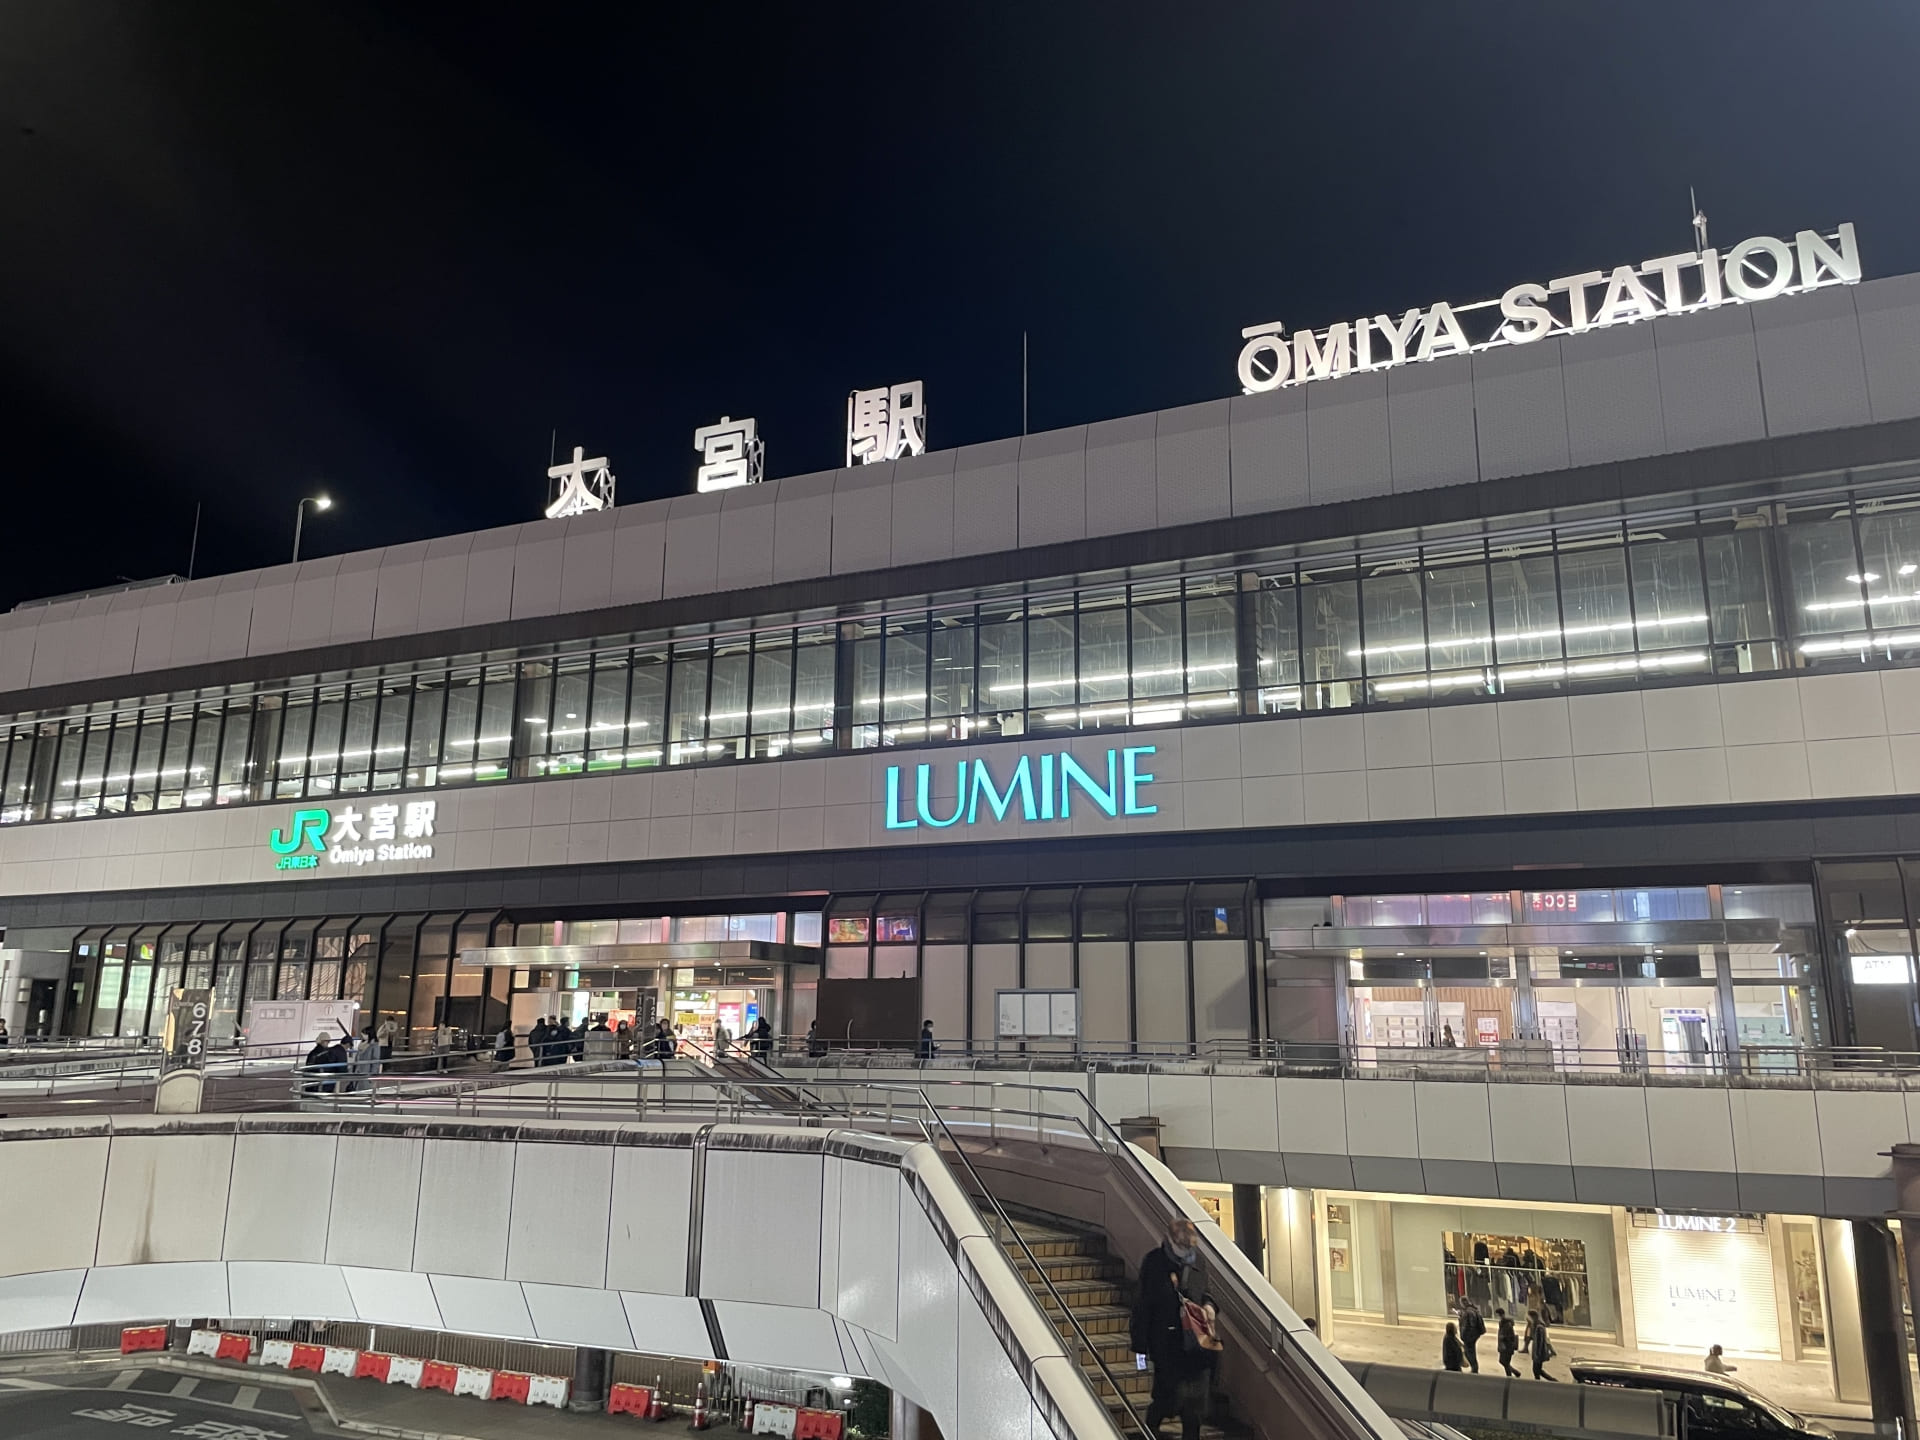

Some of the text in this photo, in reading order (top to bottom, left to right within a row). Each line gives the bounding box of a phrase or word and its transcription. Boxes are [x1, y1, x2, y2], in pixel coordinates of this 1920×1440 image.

[1500, 223, 1862, 346] STATION
[545, 380, 923, 519] 大宮駅
[886, 746, 1157, 829] LUMINE
[332, 801, 435, 842] 大宮駅
[270, 809, 329, 853] JR
[377, 842, 432, 861] Station
[275, 855, 319, 869] JR東日本
[193, 1002, 207, 1018] 6
[192, 1020, 204, 1036] 7
[187, 1038, 202, 1055] 8
[1658, 1214, 1737, 1232] LUMINE 2
[1669, 1284, 1737, 1302] LUMINE 2
